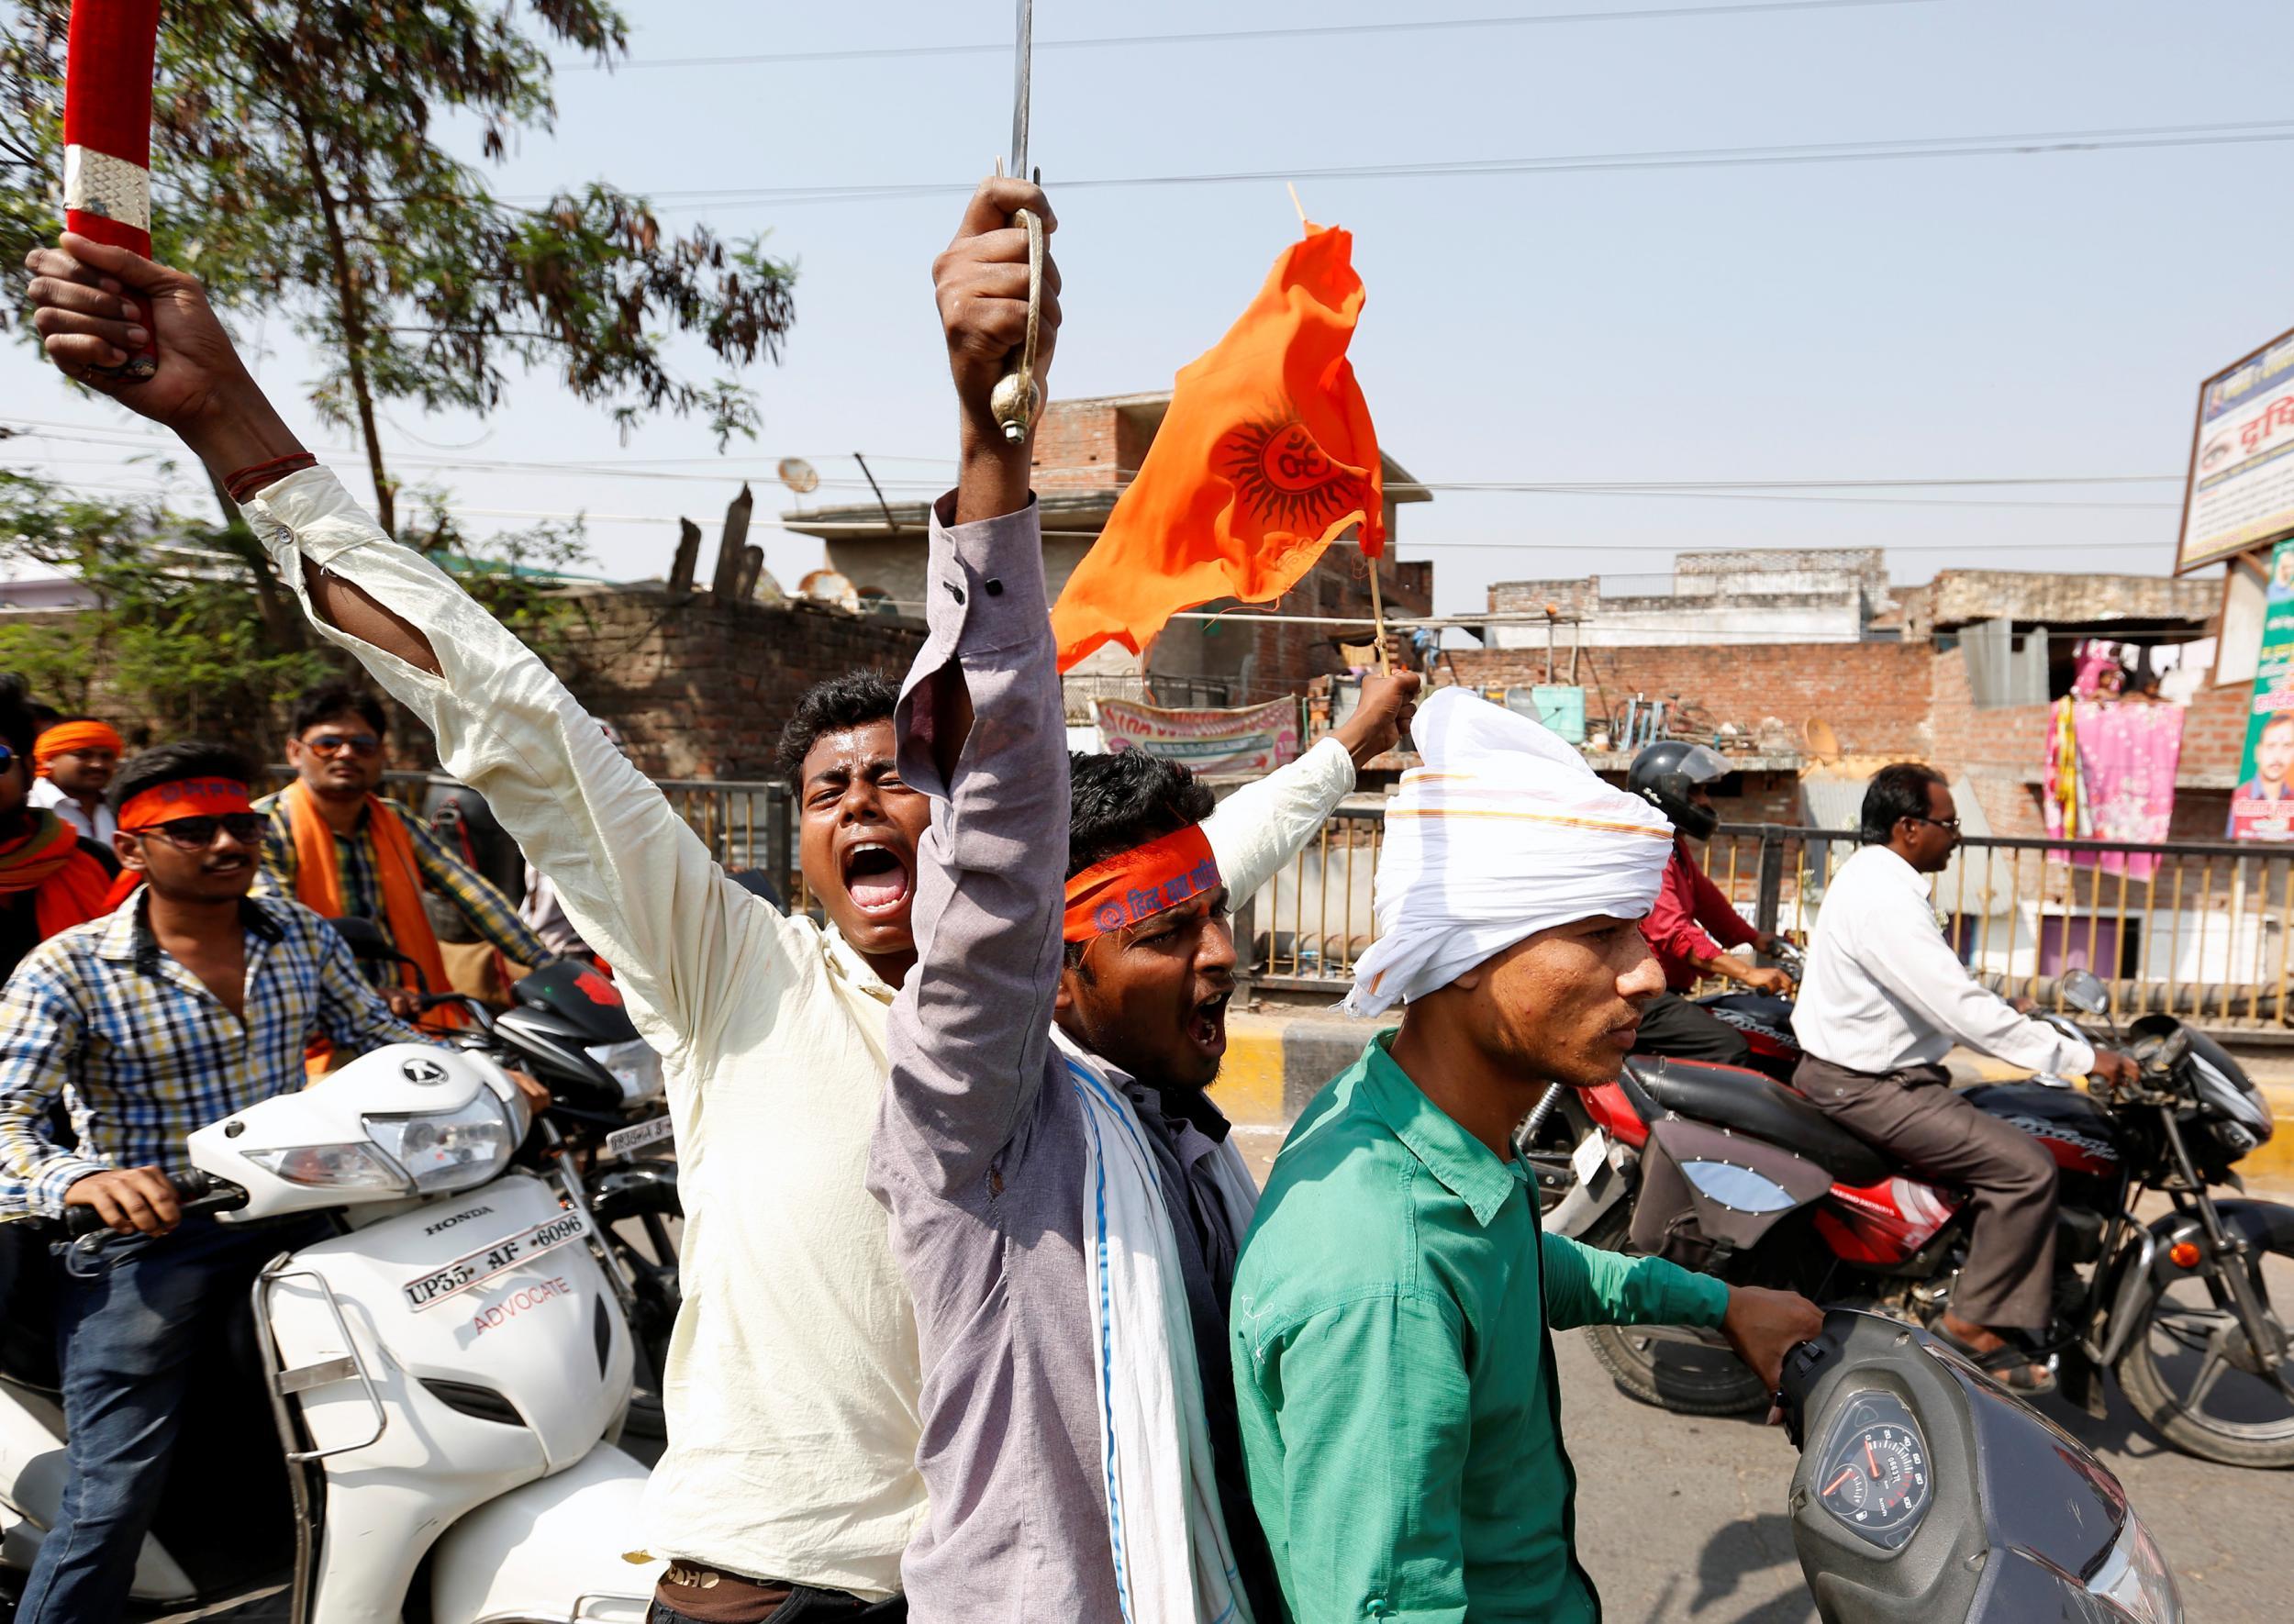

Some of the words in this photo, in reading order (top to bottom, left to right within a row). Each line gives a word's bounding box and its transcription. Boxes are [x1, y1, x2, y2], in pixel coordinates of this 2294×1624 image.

[424, 1206, 495, 1236] HONDA
[406, 1266, 469, 1307] UP35
[486, 1243, 520, 1271] AF
[537, 1217, 584, 1249] 6096
[473, 1277, 573, 1336] ADVOCATE
[1883, 1429, 1892, 1440] 20
[1903, 1436, 1911, 1447] 40
[1903, 1496, 1912, 1509] 100
